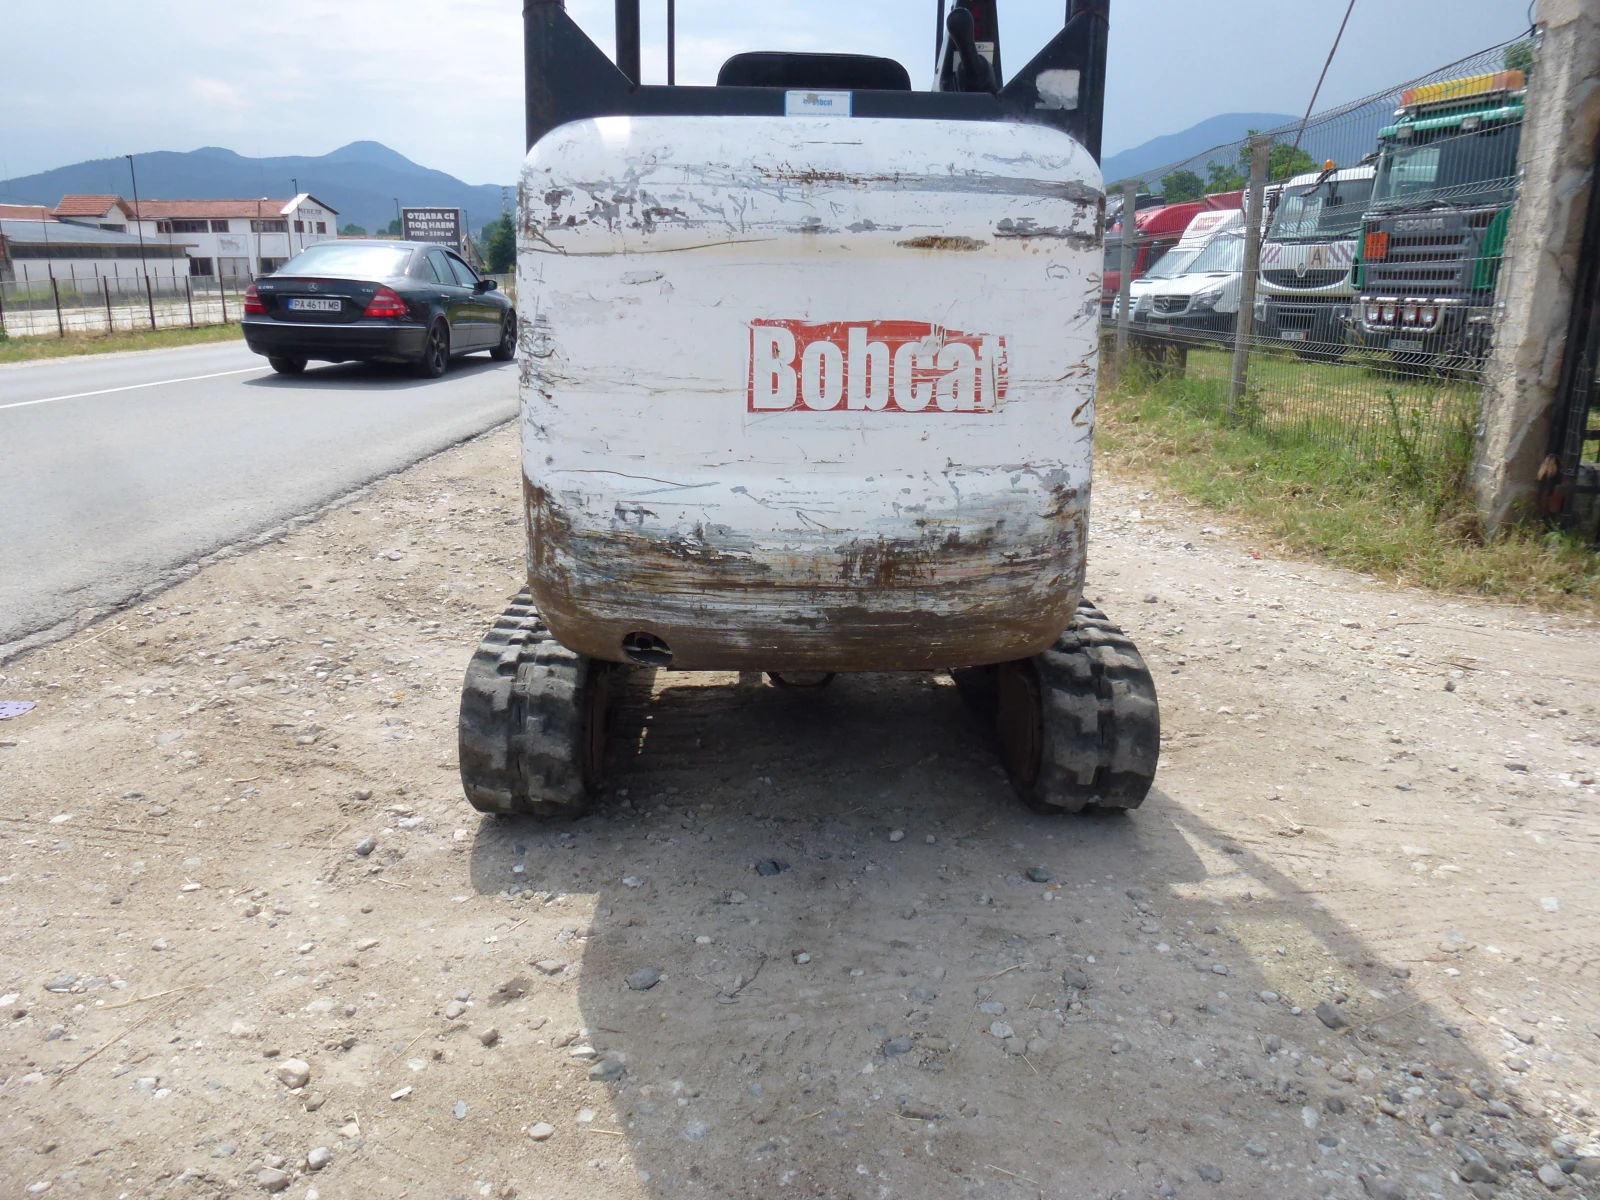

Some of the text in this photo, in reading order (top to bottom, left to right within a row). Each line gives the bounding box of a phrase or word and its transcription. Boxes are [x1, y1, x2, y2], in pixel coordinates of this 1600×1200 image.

[407, 212, 455, 220] ОТДАВА СЕ
[408, 221, 455, 230] ПОД НАЕМ
[1394, 218, 1445, 231] SCANIA
[752, 326, 1001, 412] Bobcat
